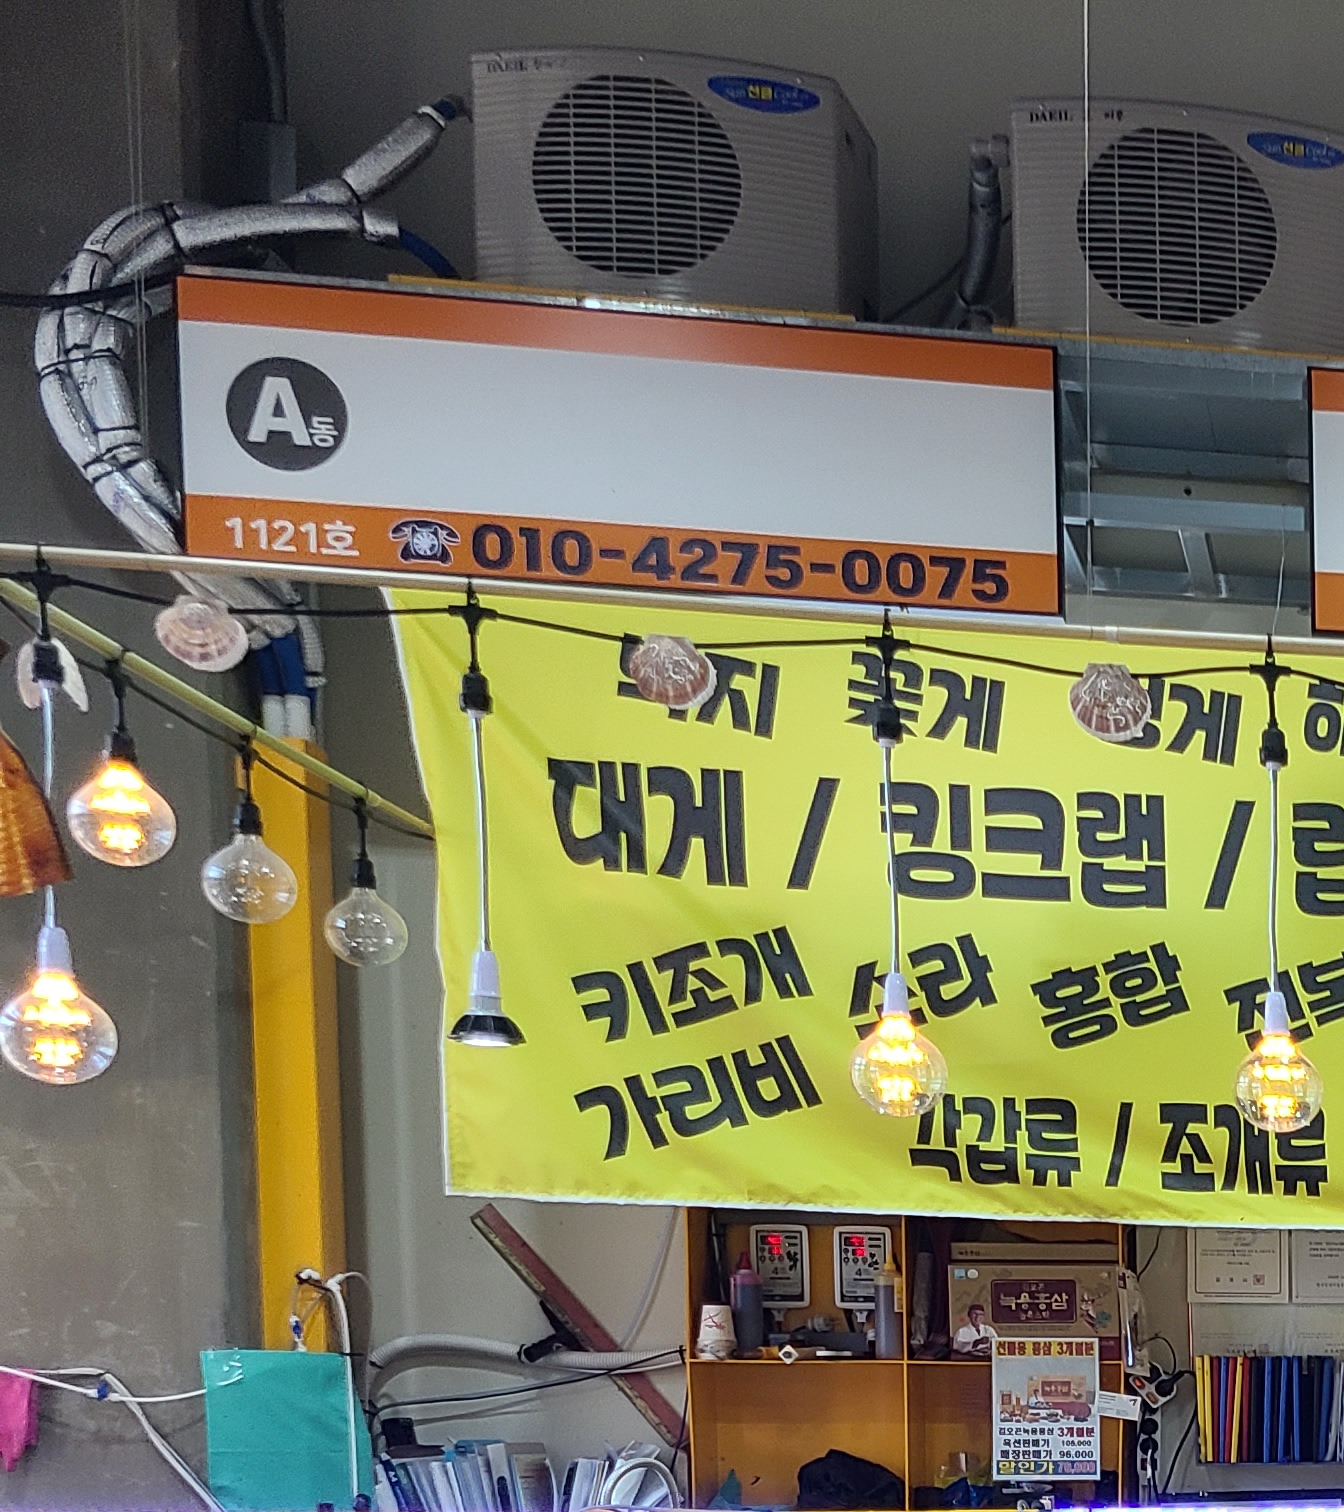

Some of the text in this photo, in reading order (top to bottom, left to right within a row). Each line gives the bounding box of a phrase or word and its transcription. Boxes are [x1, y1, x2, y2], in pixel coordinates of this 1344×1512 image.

[225, 516, 1009, 603] 1121호 010-4275-0075
[846, 651, 1006, 754] 꽃게
[547, 757, 748, 888] 대게
[880, 781, 1167, 909] 킹크랩
[570, 925, 814, 1043] 키조개
[848, 933, 998, 1041] 소라
[1030, 941, 1190, 1051] 홍합
[574, 1033, 823, 1162] 가리비
[1159, 1101, 1329, 1198] 조개류
[1000, 1292, 1069, 1311] 녹용홍삼
[1057, 1341, 1094, 1356] 3개월분
[998, 1461, 1054, 1474] 할인가
[1057, 1427, 1095, 1437] 3개월분
